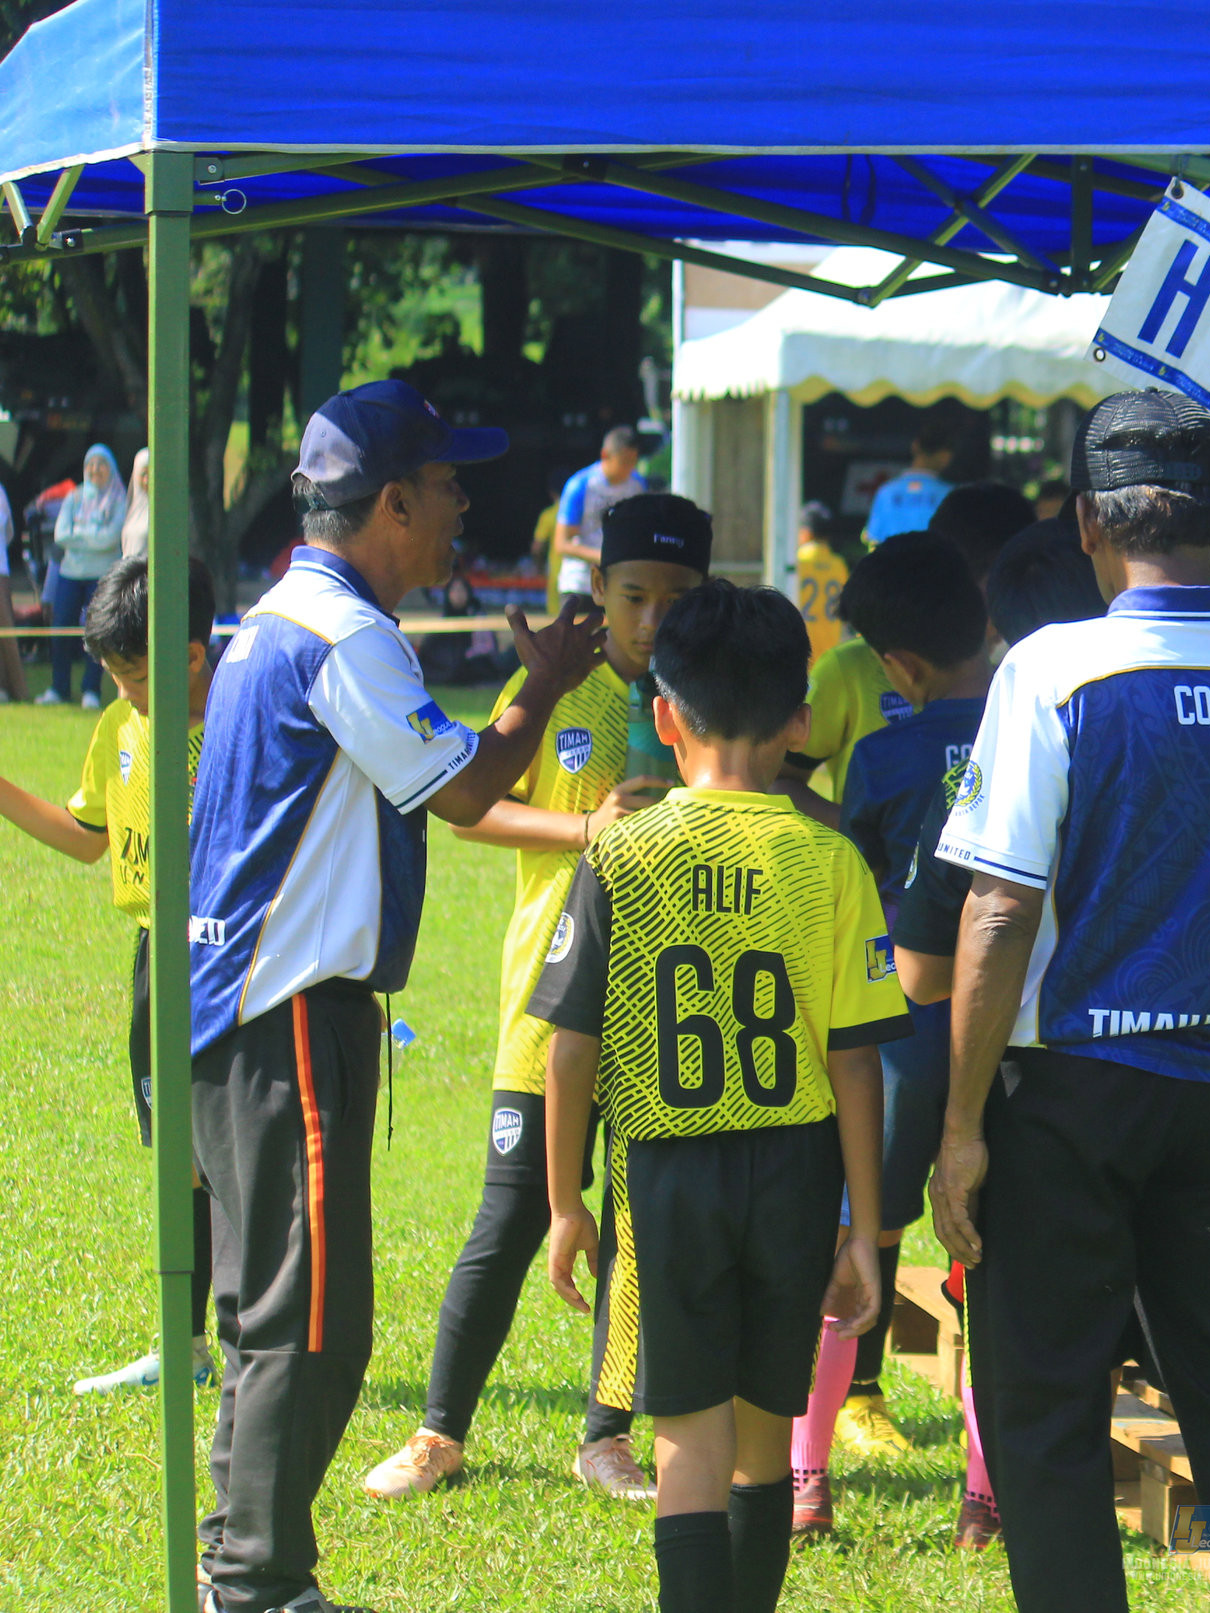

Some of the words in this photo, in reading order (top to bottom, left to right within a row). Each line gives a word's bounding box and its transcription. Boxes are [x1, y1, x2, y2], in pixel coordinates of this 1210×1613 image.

[559, 731, 588, 750] TIMAH
[937, 842, 972, 861] UNITED
[691, 863, 764, 916] ALIF
[655, 944, 797, 1110] 68
